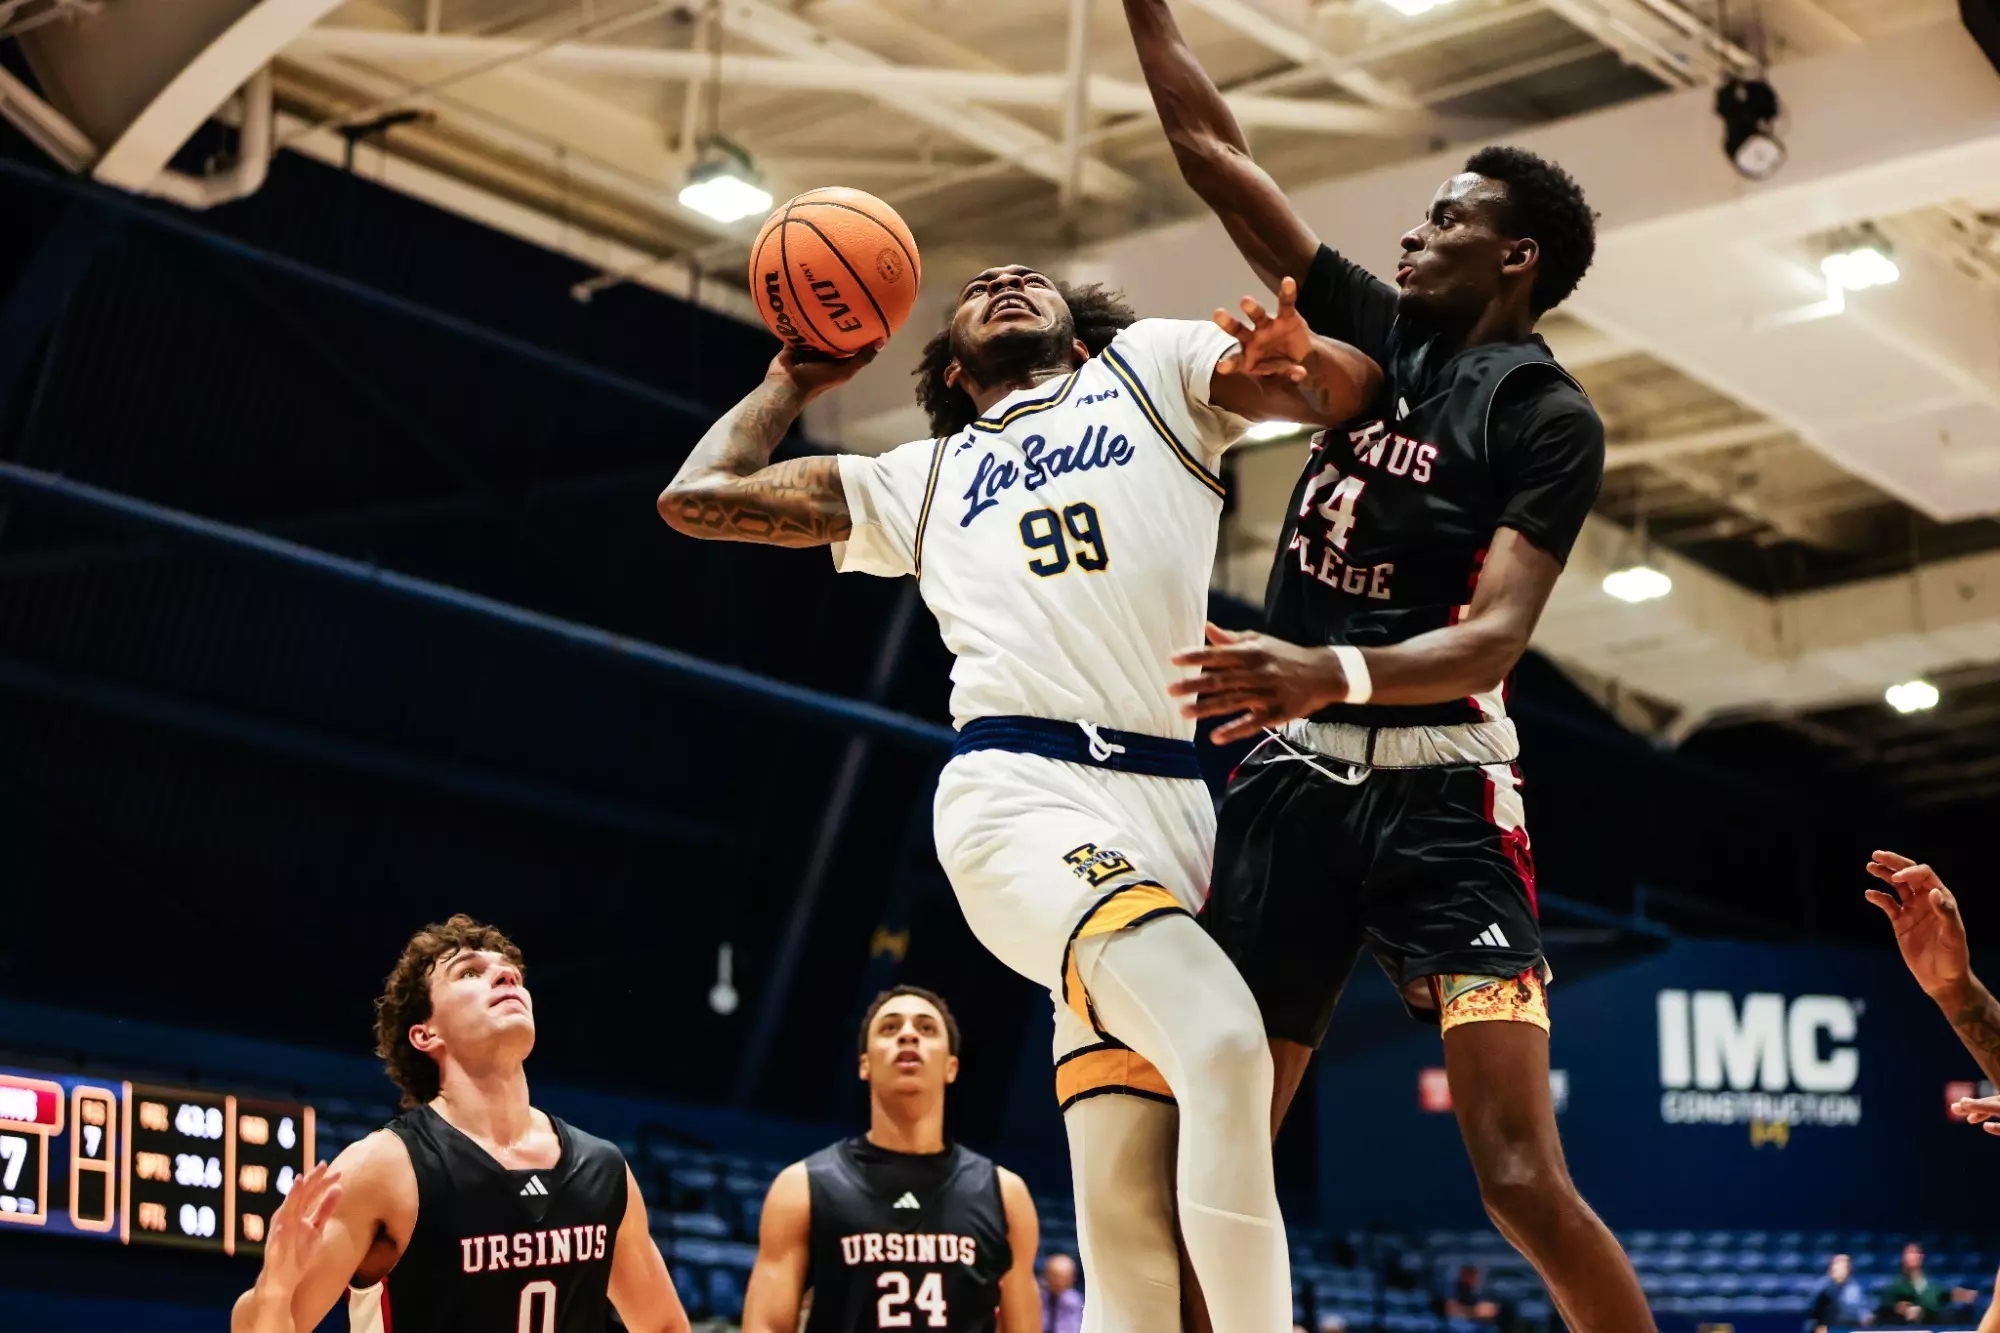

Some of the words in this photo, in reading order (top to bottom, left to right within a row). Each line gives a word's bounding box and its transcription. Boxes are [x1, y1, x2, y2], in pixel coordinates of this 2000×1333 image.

[810, 280, 862, 333] EVO
[960, 452, 1019, 527] La
[1022, 425, 1136, 491] Salle
[1019, 502, 1109, 578] 99
[1657, 989, 1859, 1091] IMC
[460, 1223, 608, 1273] URSINUS
[840, 1232, 976, 1266] URSINUS
[518, 1279, 558, 1333] 0
[876, 1270, 948, 1328] 24
